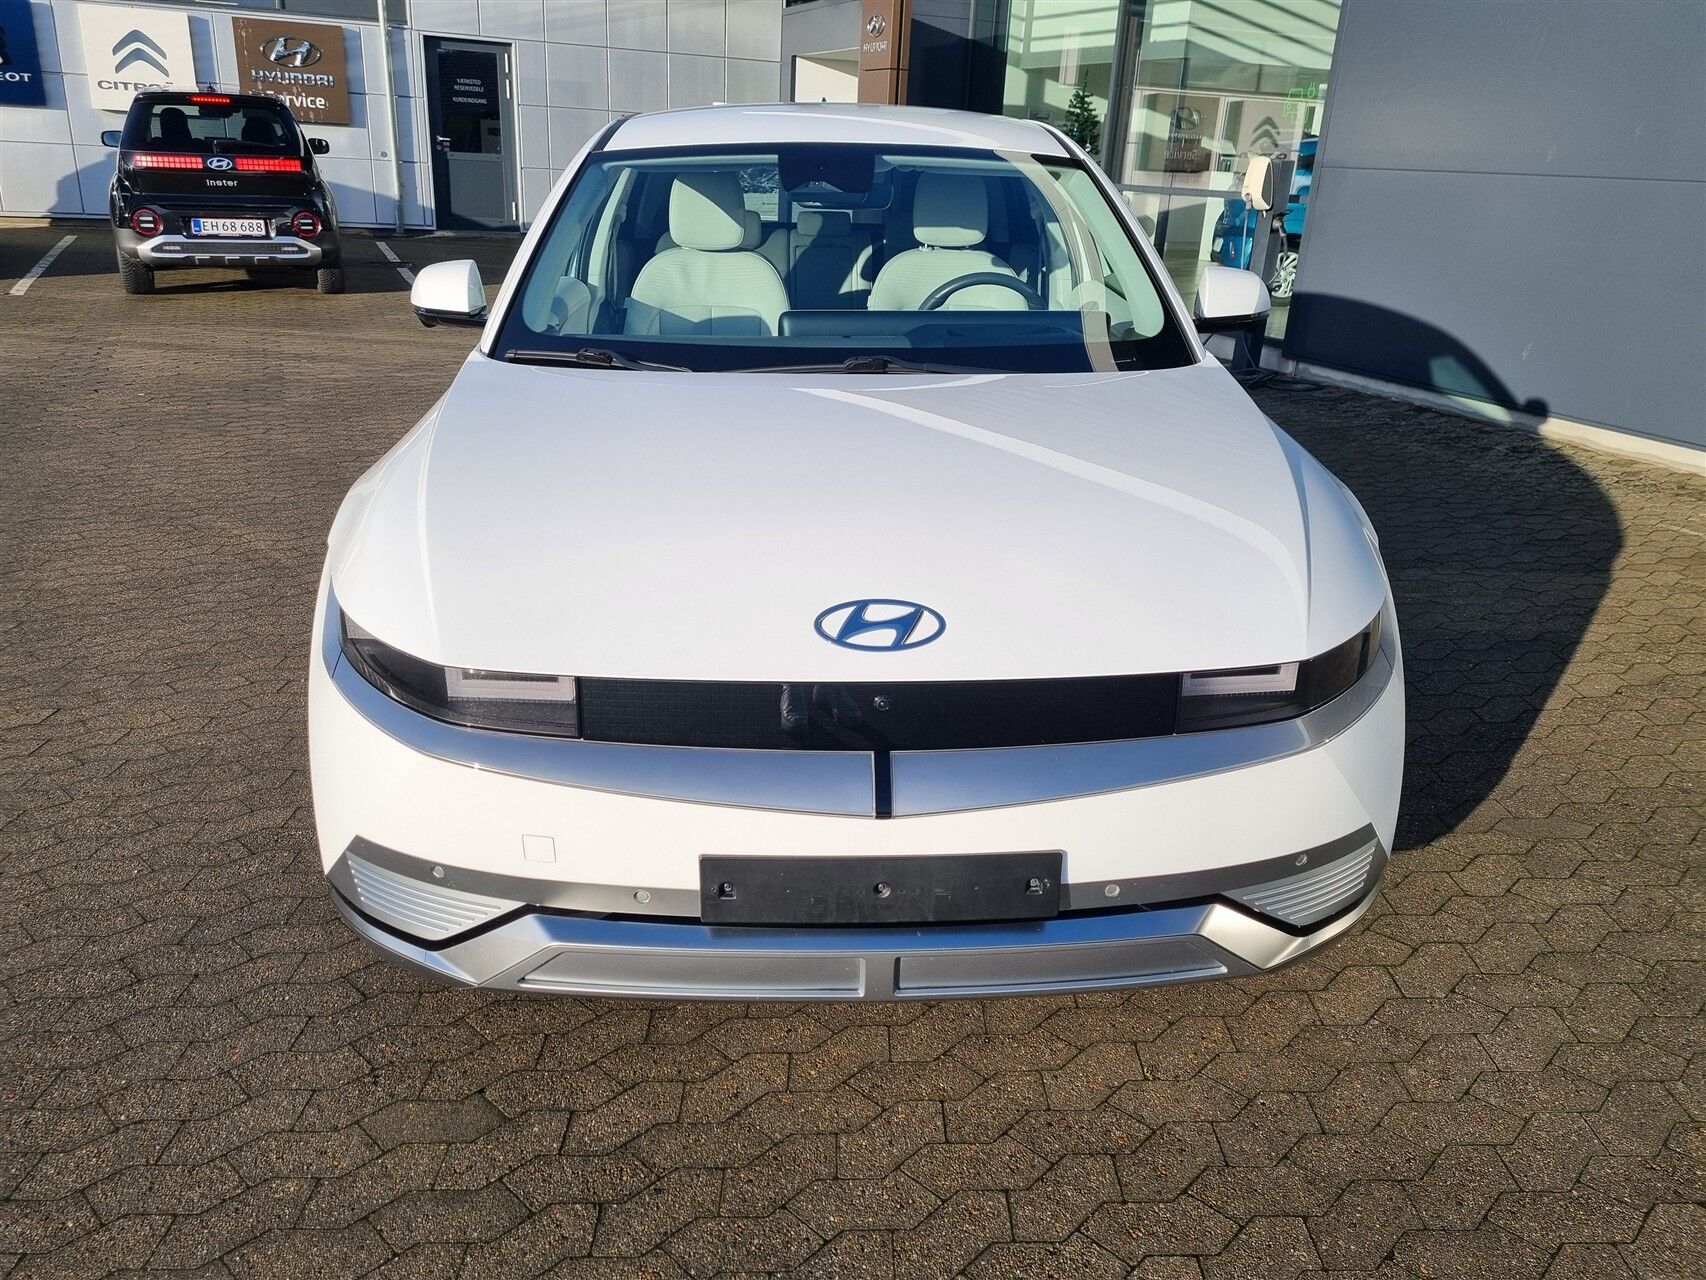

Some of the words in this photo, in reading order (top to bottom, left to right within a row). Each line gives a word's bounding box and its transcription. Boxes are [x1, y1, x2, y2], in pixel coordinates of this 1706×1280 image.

[251, 69, 333, 86] HYUNDAI
[202, 220, 219, 232] EH
[222, 221, 237, 232] 68
[240, 222, 263, 232] 688
